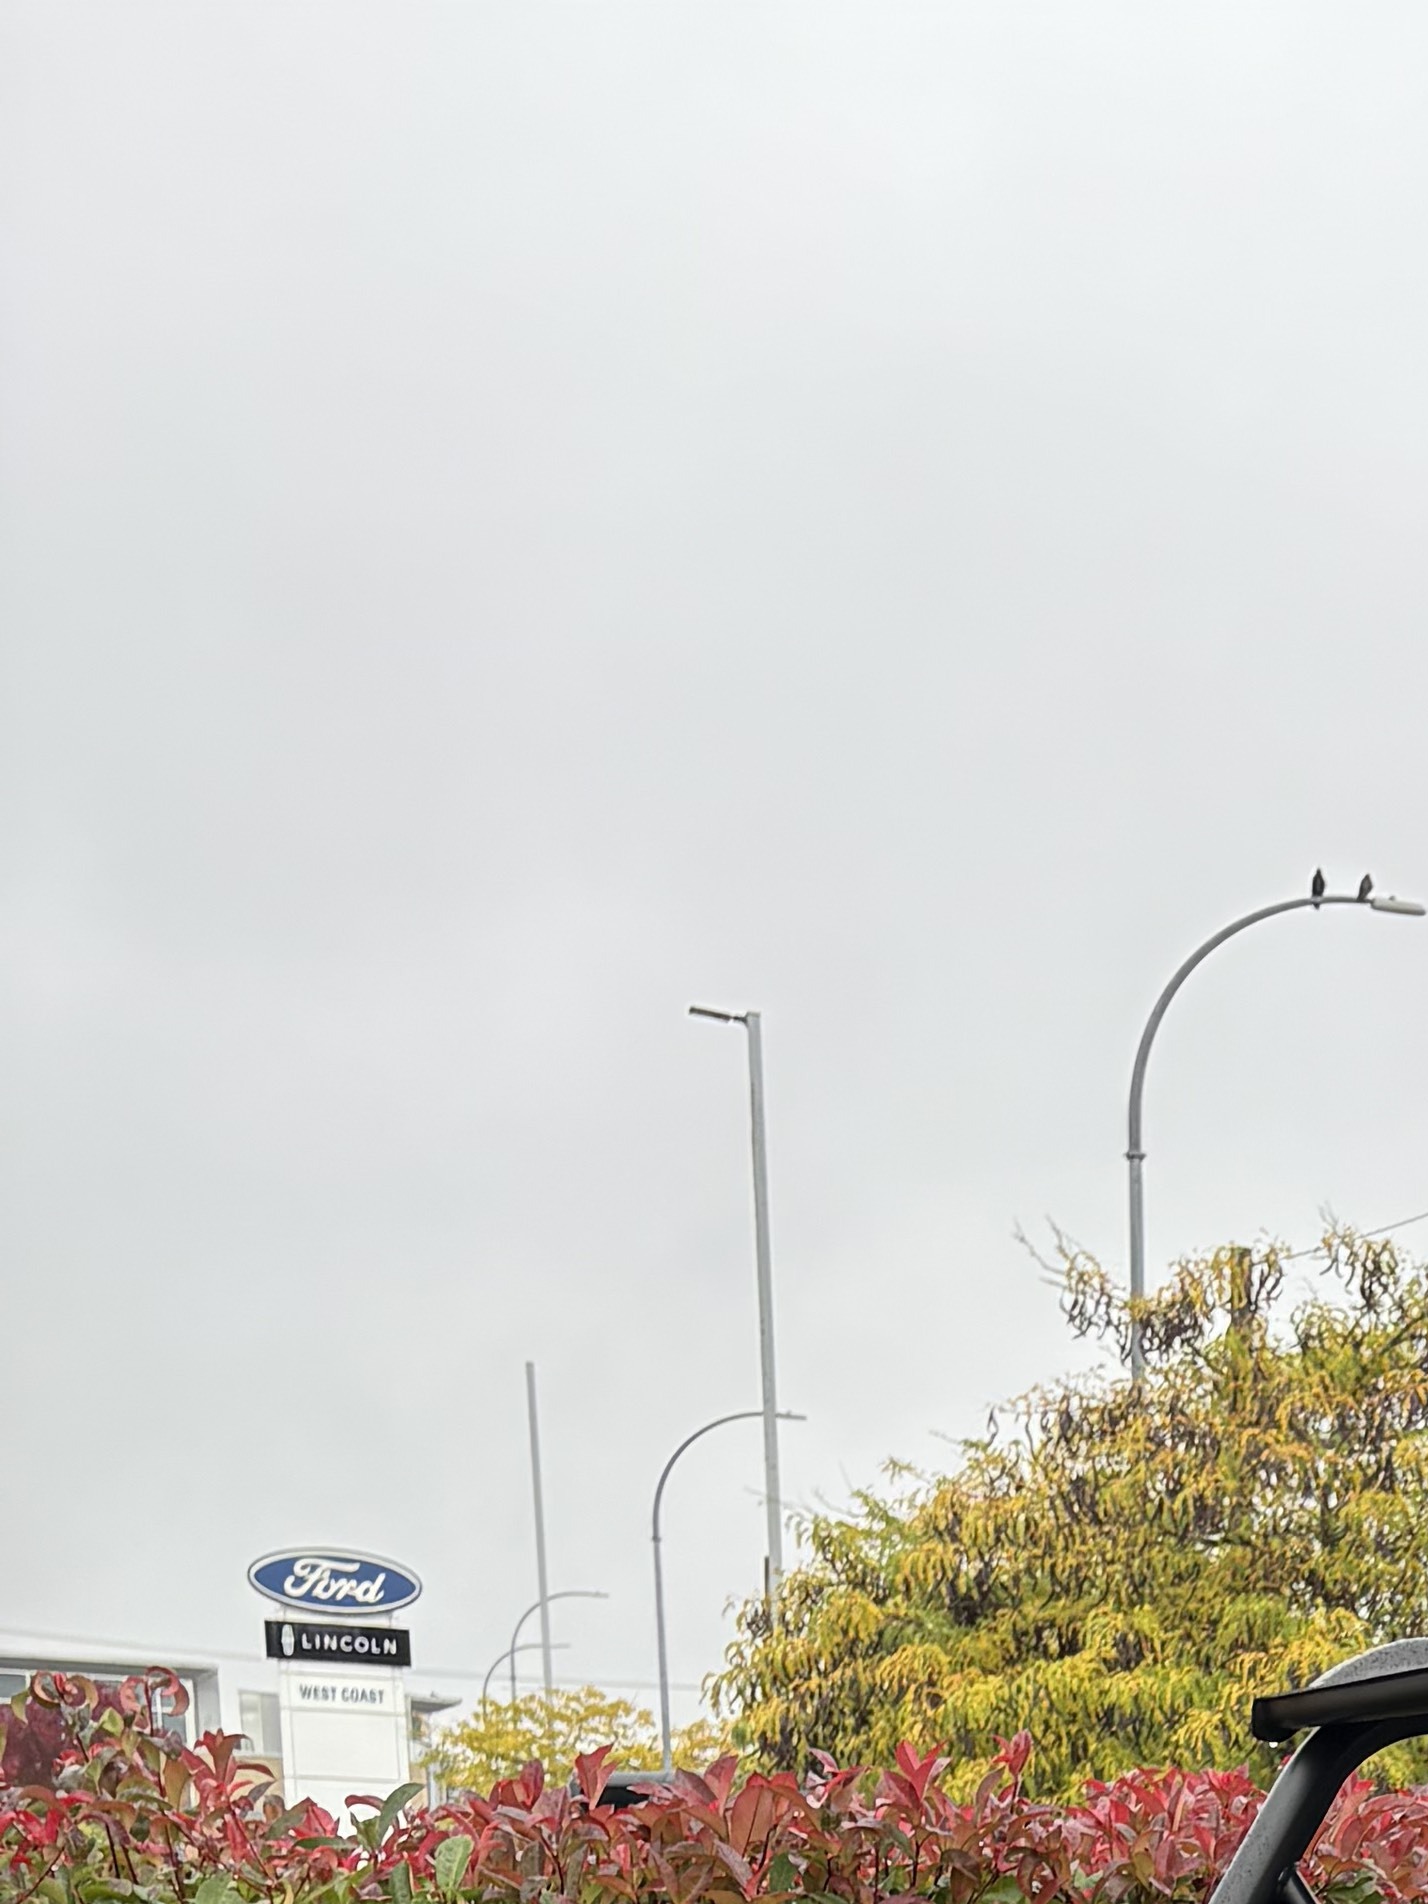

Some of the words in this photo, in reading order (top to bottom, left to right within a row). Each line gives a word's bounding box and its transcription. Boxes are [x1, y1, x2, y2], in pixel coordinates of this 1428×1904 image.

[283, 1557, 388, 1603] Ford
[301, 1632, 397, 1655] LINCOLN
[299, 1684, 336, 1701] WEST
[341, 1687, 385, 1704] COAST
